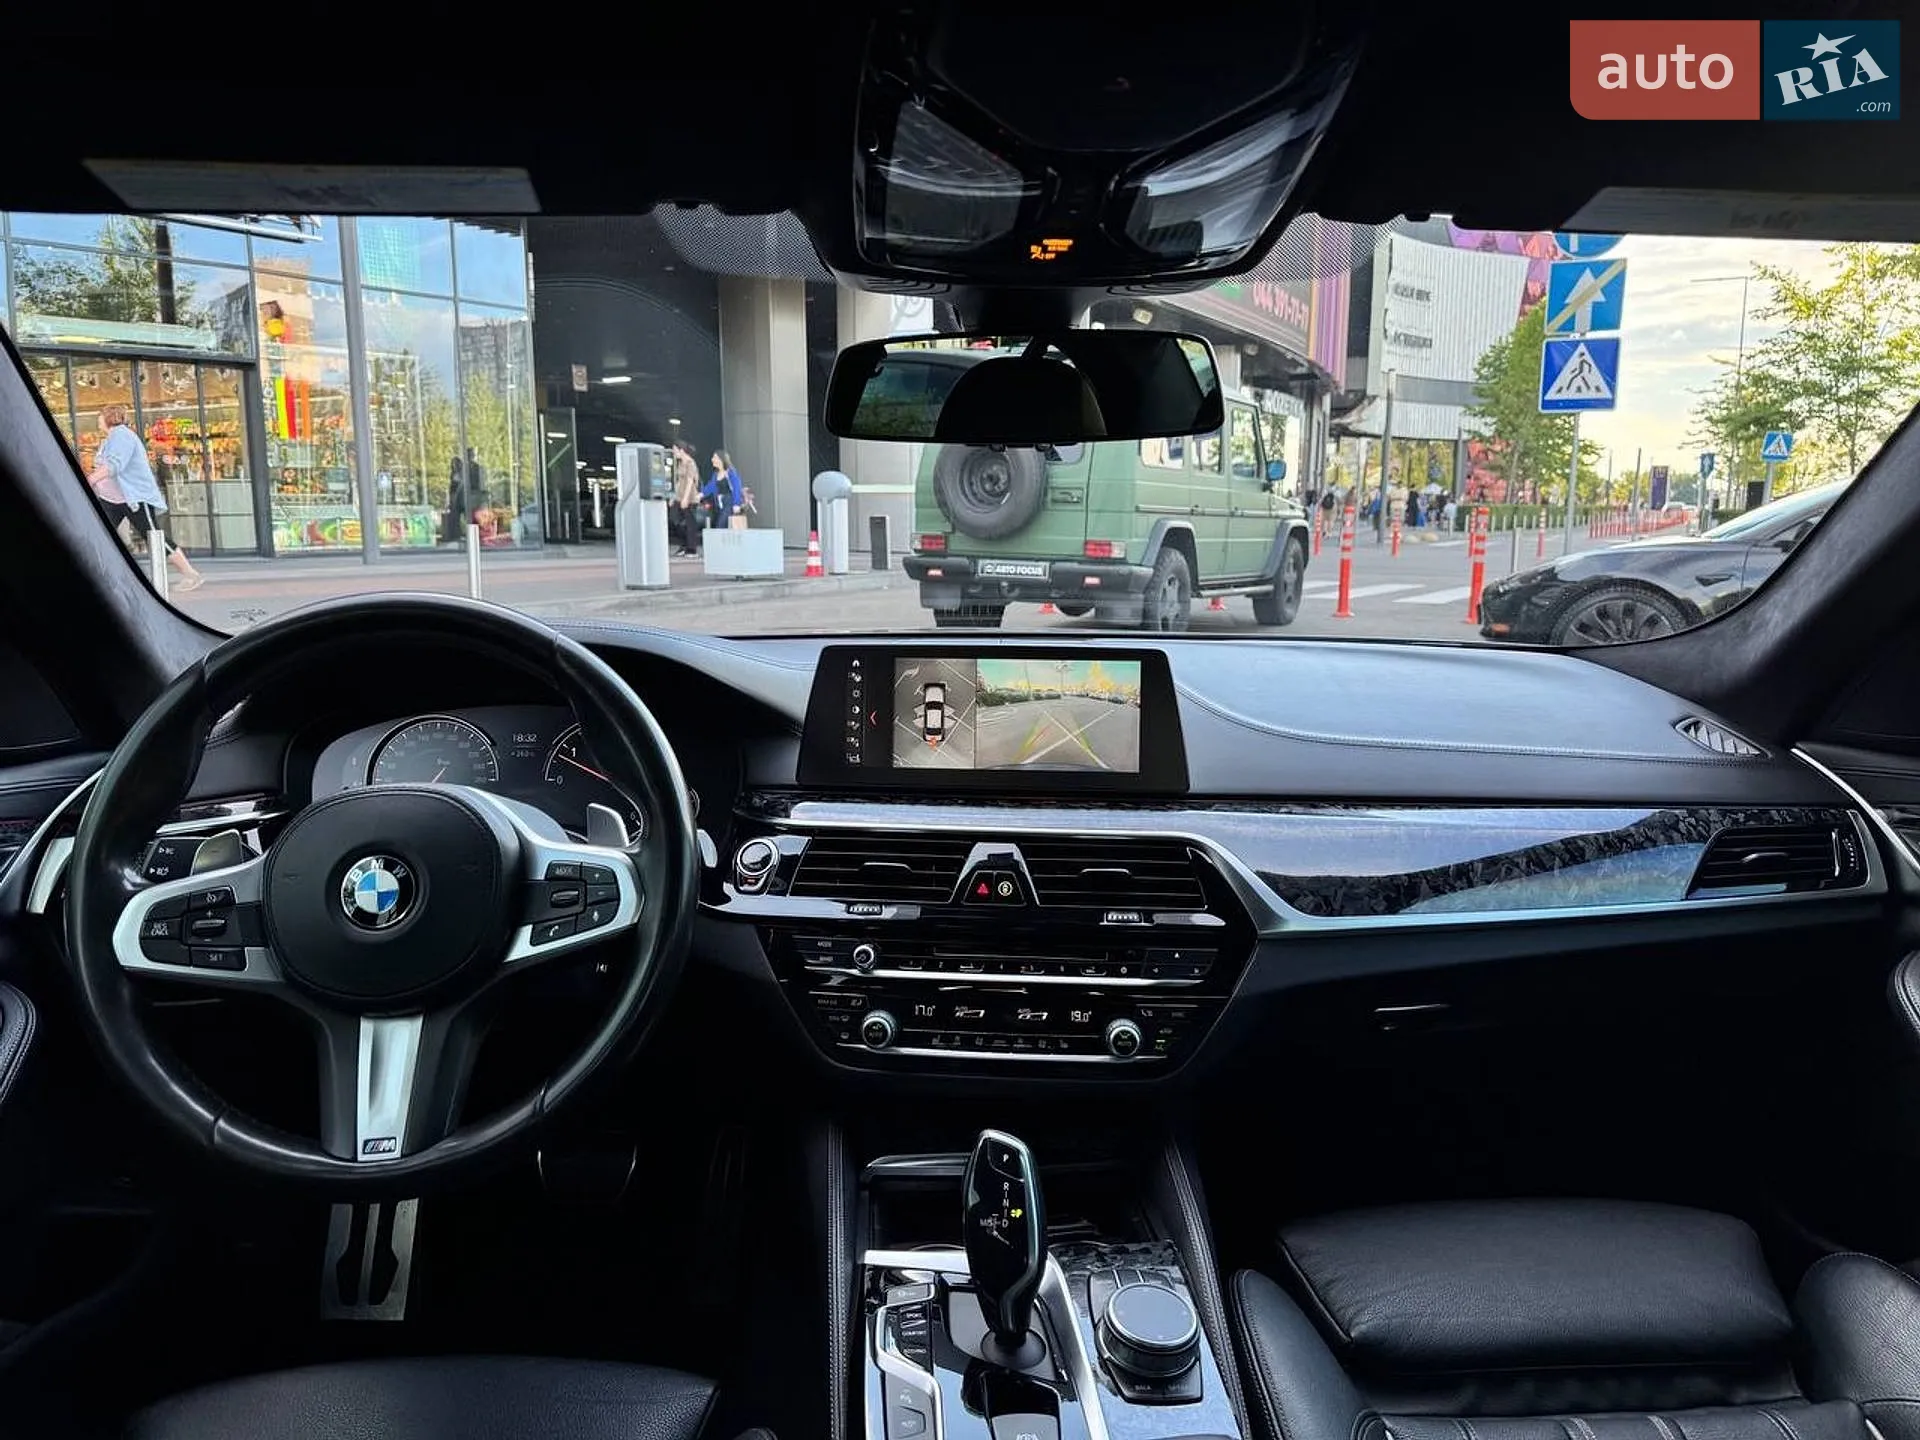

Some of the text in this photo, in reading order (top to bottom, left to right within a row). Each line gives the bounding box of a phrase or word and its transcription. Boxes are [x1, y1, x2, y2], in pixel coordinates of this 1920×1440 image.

[512, 734, 537, 742] 18:32
[571, 747, 576, 757] 1
[556, 775, 563, 785] 0
[350, 859, 407, 882] BMW
[1003, 1154, 1009, 1162] P
[1003, 1182, 1009, 1191] R
[1003, 1199, 1009, 1207] N
[1002, 1219, 1008, 1228] D
